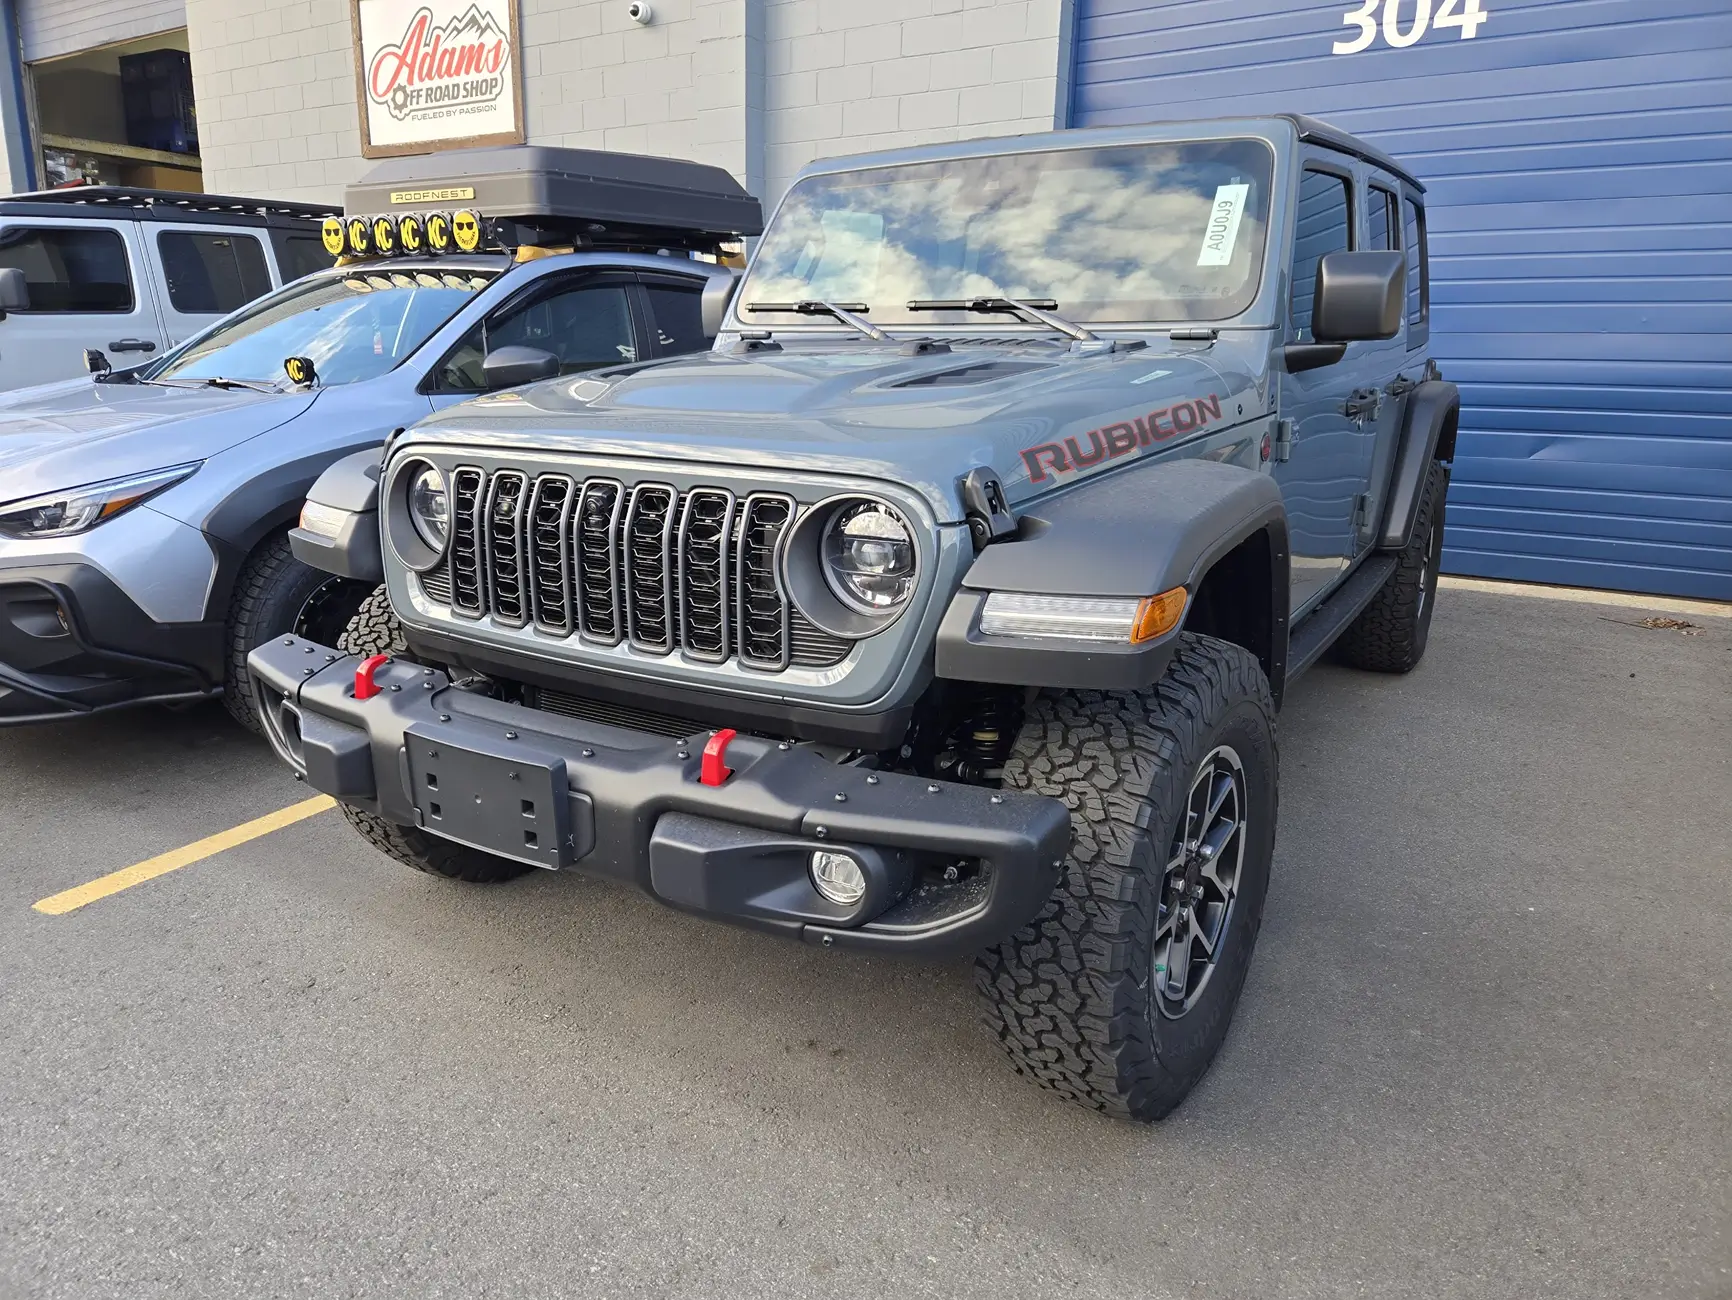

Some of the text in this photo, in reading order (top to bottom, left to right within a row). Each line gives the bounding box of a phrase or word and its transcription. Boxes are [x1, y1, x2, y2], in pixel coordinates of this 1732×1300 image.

[1332, 0, 1488, 55] 304
[372, 15, 506, 98] Adams
[425, 83, 460, 104] ROAD
[462, 77, 498, 99] SHOP
[411, 104, 497, 121] FUELED BY PASSION
[395, 189, 468, 202] ROOFNEST
[349, 221, 366, 251] KC
[374, 220, 392, 250] KC
[400, 217, 420, 250] KC
[427, 216, 448, 249] KC
[287, 359, 303, 380] KC
[1018, 393, 1223, 484] RUBICON
